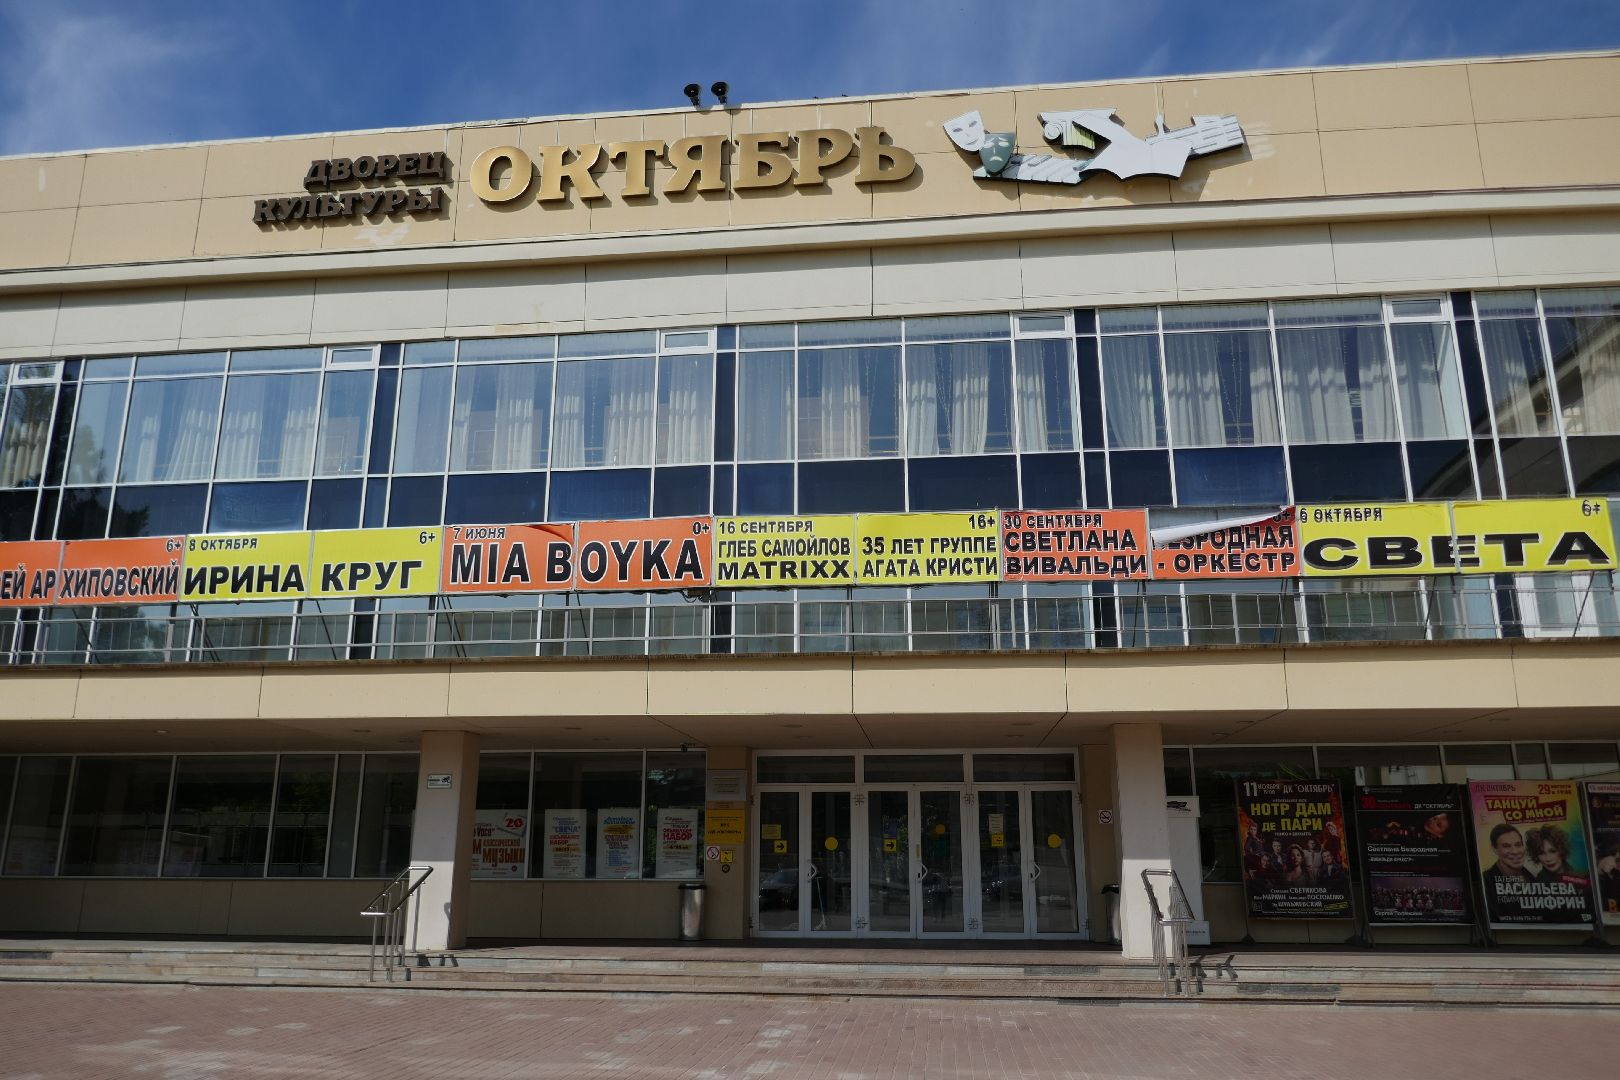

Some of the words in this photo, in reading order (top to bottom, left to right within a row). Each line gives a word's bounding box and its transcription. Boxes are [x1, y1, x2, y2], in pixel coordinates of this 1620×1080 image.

[304, 152, 446, 190] ДВОРЕЦ
[469, 126, 916, 203] ОКТЯБРЬ
[252, 186, 445, 226] КУЛЬТУРЫ
[1300, 507, 1309, 523] 6
[1313, 507, 1383, 522] ОКТЯБРЯ
[1581, 499, 1601, 517] 6+
[692, 521, 710, 535] 0+
[719, 520, 736, 534] 16
[740, 520, 813, 534] СЕНТЯБРЯ
[968, 514, 996, 530] 16+
[1003, 514, 1022, 529] 30
[1026, 514, 1102, 529] СЕНТЯБРЯ
[419, 531, 436, 544] 6+
[453, 527, 461, 540] 7
[465, 527, 506, 540] ИЮНЯ
[1004, 529, 1137, 553] СВЕТЛАНА
[1153, 525, 1294, 553] ЗРОДНАЯ
[166, 538, 182, 552] 6+
[189, 539, 197, 551] 8
[201, 538, 258, 551] ОКТЯБРЯ
[718, 539, 758, 558] ГЛЕБ
[761, 535, 851, 557] САМОЙЛОВ
[862, 536, 885, 556] 35
[890, 538, 925, 555] ЛЕТ
[930, 536, 997, 555] ГРУППЕ
[1303, 531, 1610, 571] СВЕТА
[450, 542, 531, 584] MIA
[546, 539, 704, 583] BOYKA
[717, 559, 851, 580] MATRIXX
[862, 558, 921, 578] АГАТА
[926, 556, 998, 577] КРИСТИ
[1006, 555, 1147, 577] ВИВАЛЬДИ
[1173, 552, 1296, 573] ОРКЕСТР
[0, 563, 26, 599] ЕЙ
[184, 563, 305, 596] ИРИНА
[321, 559, 423, 592] КРУГ
[1243, 781, 1258, 797] 11
[1538, 784, 1551, 795] 29
[1250, 802, 1290, 816] НОТР
[1295, 802, 1332, 818] ДАМ
[1487, 796, 1537, 810] ТАНЦУЙ
[1505, 810, 1523, 821] СО
[1526, 804, 1564, 819] МНОЙ
[1281, 818, 1323, 831] ПАРИ
[663, 832, 693, 841] НАБОР
[1495, 882, 1576, 895] ВАСИЛЬЕВА
[1520, 896, 1585, 910] ШИФРИН
